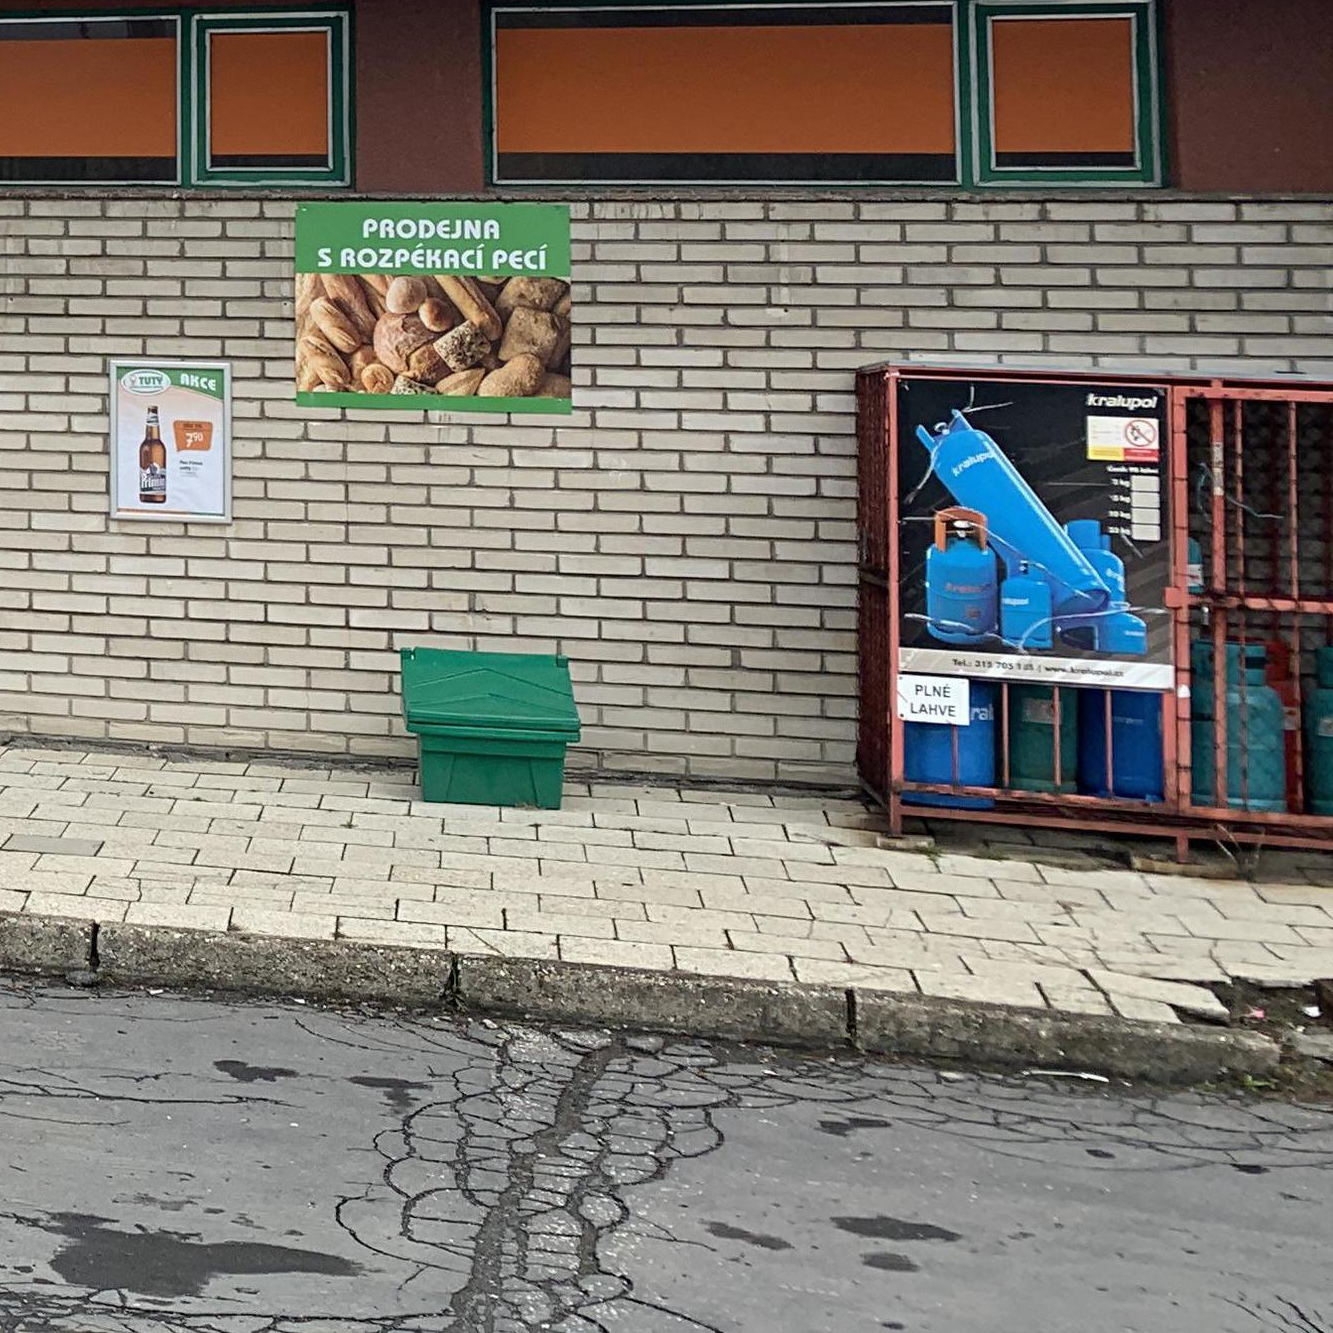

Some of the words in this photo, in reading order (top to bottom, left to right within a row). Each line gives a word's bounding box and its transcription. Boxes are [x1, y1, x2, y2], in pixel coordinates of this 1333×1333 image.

[362, 218, 500, 239] PRODEJNA
[318, 248, 332, 267] S
[340, 243, 485, 269] ROZPÉKACÍ
[492, 243, 548, 270] PECÍ
[139, 376, 163, 385] TUTY
[180, 373, 216, 391] AKCE
[1085, 393, 1157, 410] kralupol
[915, 680, 952, 698] PLNÉ
[910, 702, 956, 717] LAHVE
